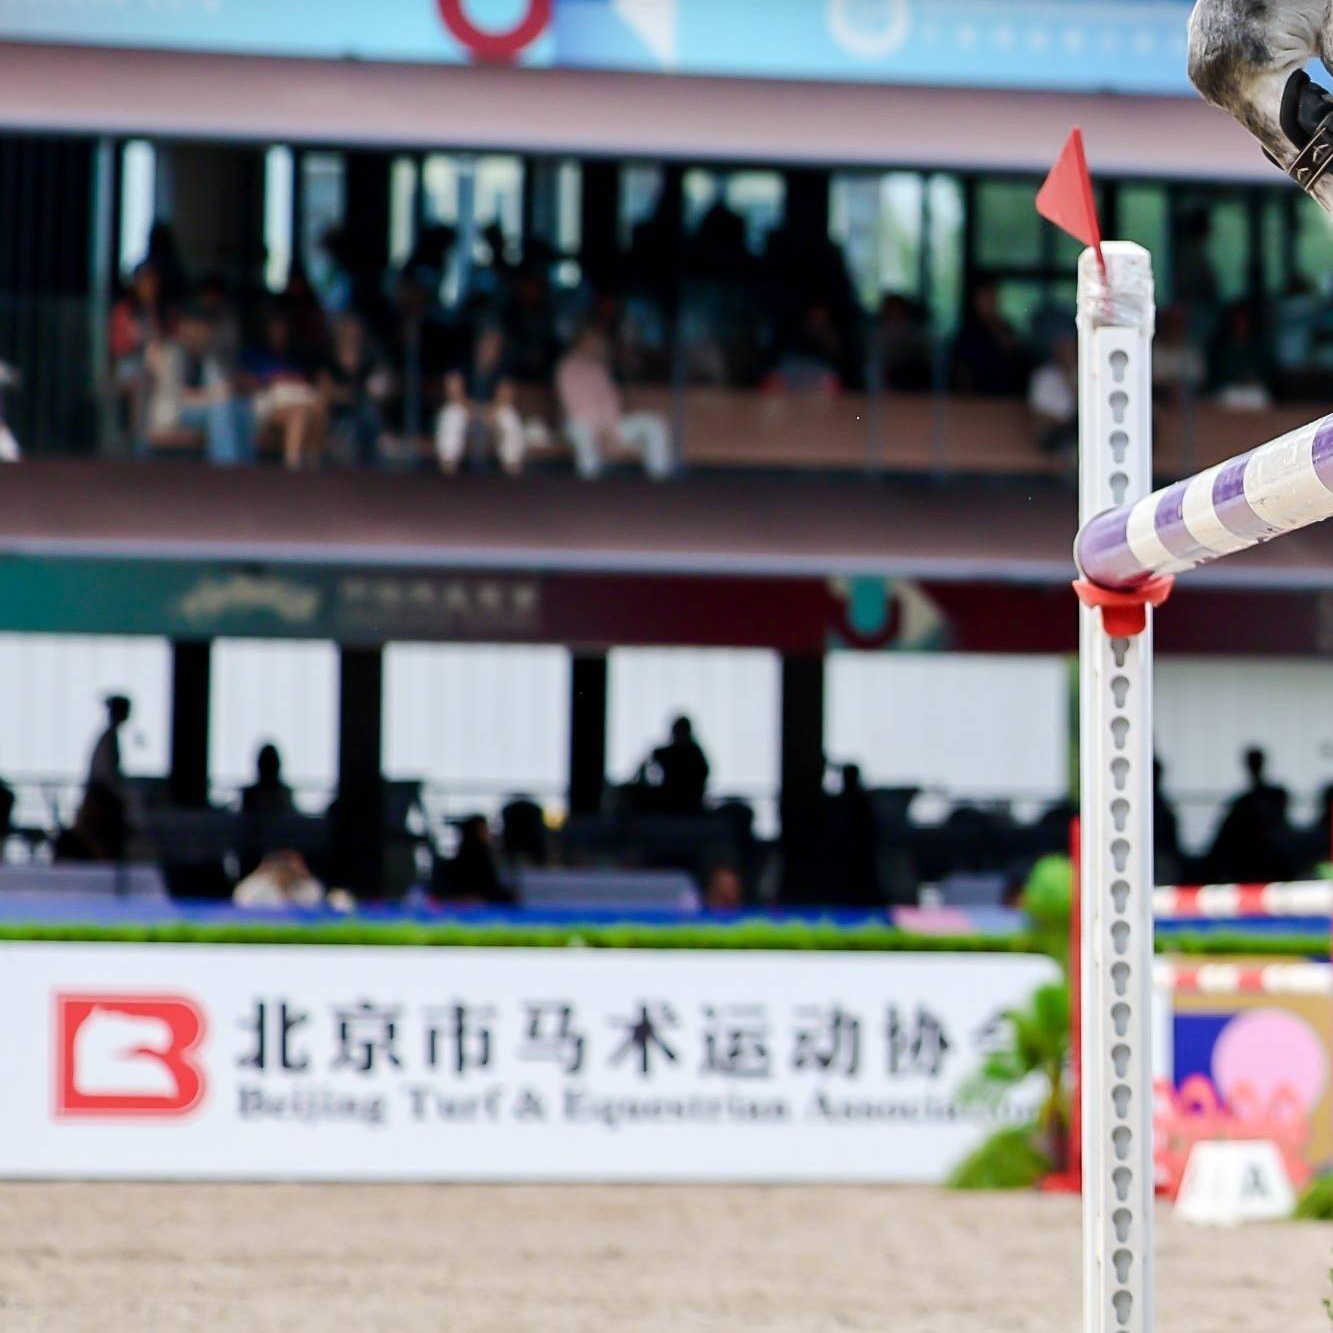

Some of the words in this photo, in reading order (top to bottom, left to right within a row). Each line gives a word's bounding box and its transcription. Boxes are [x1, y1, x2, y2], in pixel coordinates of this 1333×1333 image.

[237, 1084, 387, 1128] Beijing
[406, 1083, 502, 1122] Turf
[510, 1085, 548, 1121] &
[562, 1086, 791, 1130] Equestrian
